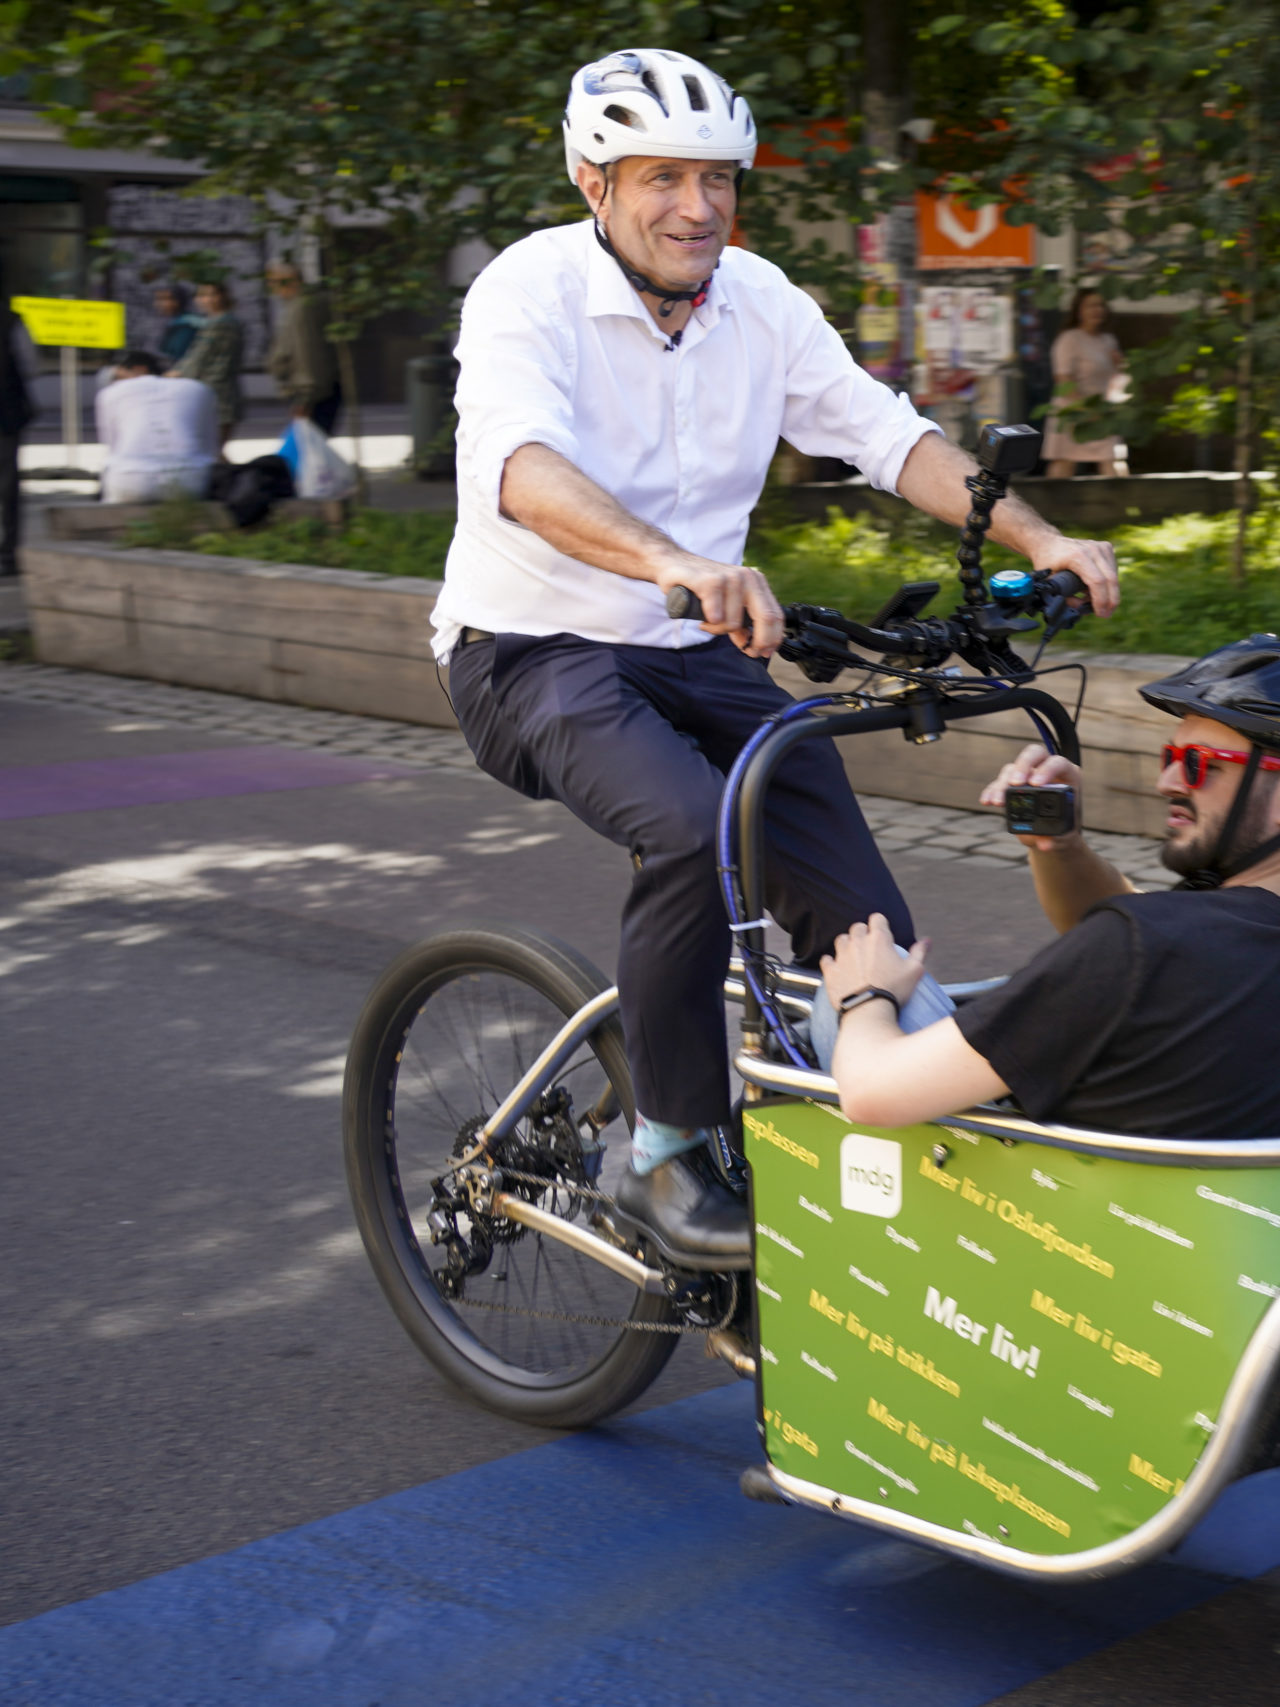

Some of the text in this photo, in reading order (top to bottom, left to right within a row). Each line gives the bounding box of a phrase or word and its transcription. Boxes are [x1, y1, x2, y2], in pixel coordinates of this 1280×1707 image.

[848, 1164, 895, 1197] mdg
[919, 1155, 961, 1193] Mer
[960, 1176, 987, 1207] liv
[985, 1191, 998, 1214] i
[997, 1199, 1116, 1280] Oslofjorden
[809, 1288, 846, 1326] Mer
[845, 1311, 869, 1341] liv
[868, 1332, 895, 1359] på
[923, 1285, 1041, 1378] Mer liv!
[1030, 1288, 1163, 1379] Mer liv i gata
[773, 1410, 782, 1430] i
[781, 1421, 819, 1459] gata
[867, 1396, 906, 1436] Mer
[905, 1420, 930, 1451] liv
[929, 1442, 957, 1470] på
[958, 1452, 1071, 1539] lekeplassen
[1128, 1452, 1175, 1495] Mer
